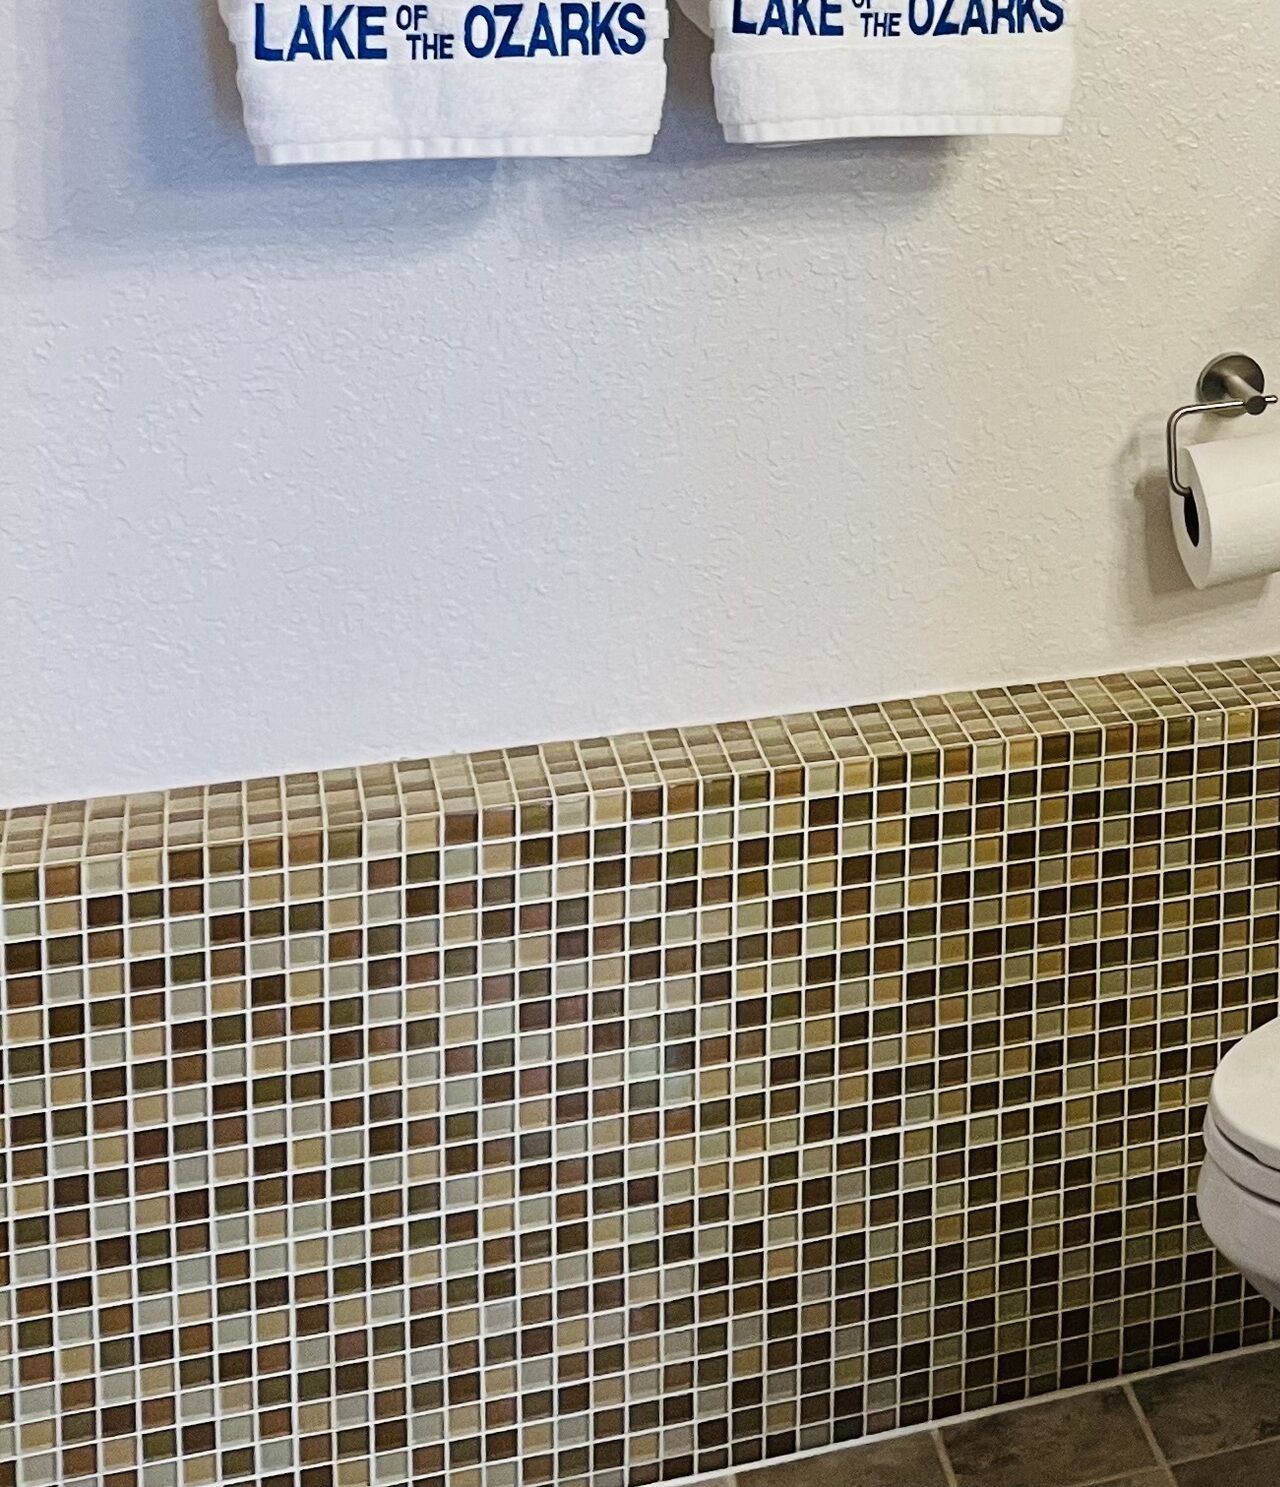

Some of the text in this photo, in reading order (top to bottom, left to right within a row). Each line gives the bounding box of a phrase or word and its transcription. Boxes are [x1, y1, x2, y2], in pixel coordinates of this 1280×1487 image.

[255, 2, 646, 61] LAKE OF THE OZARKS
[861, 12, 901, 37] THE
